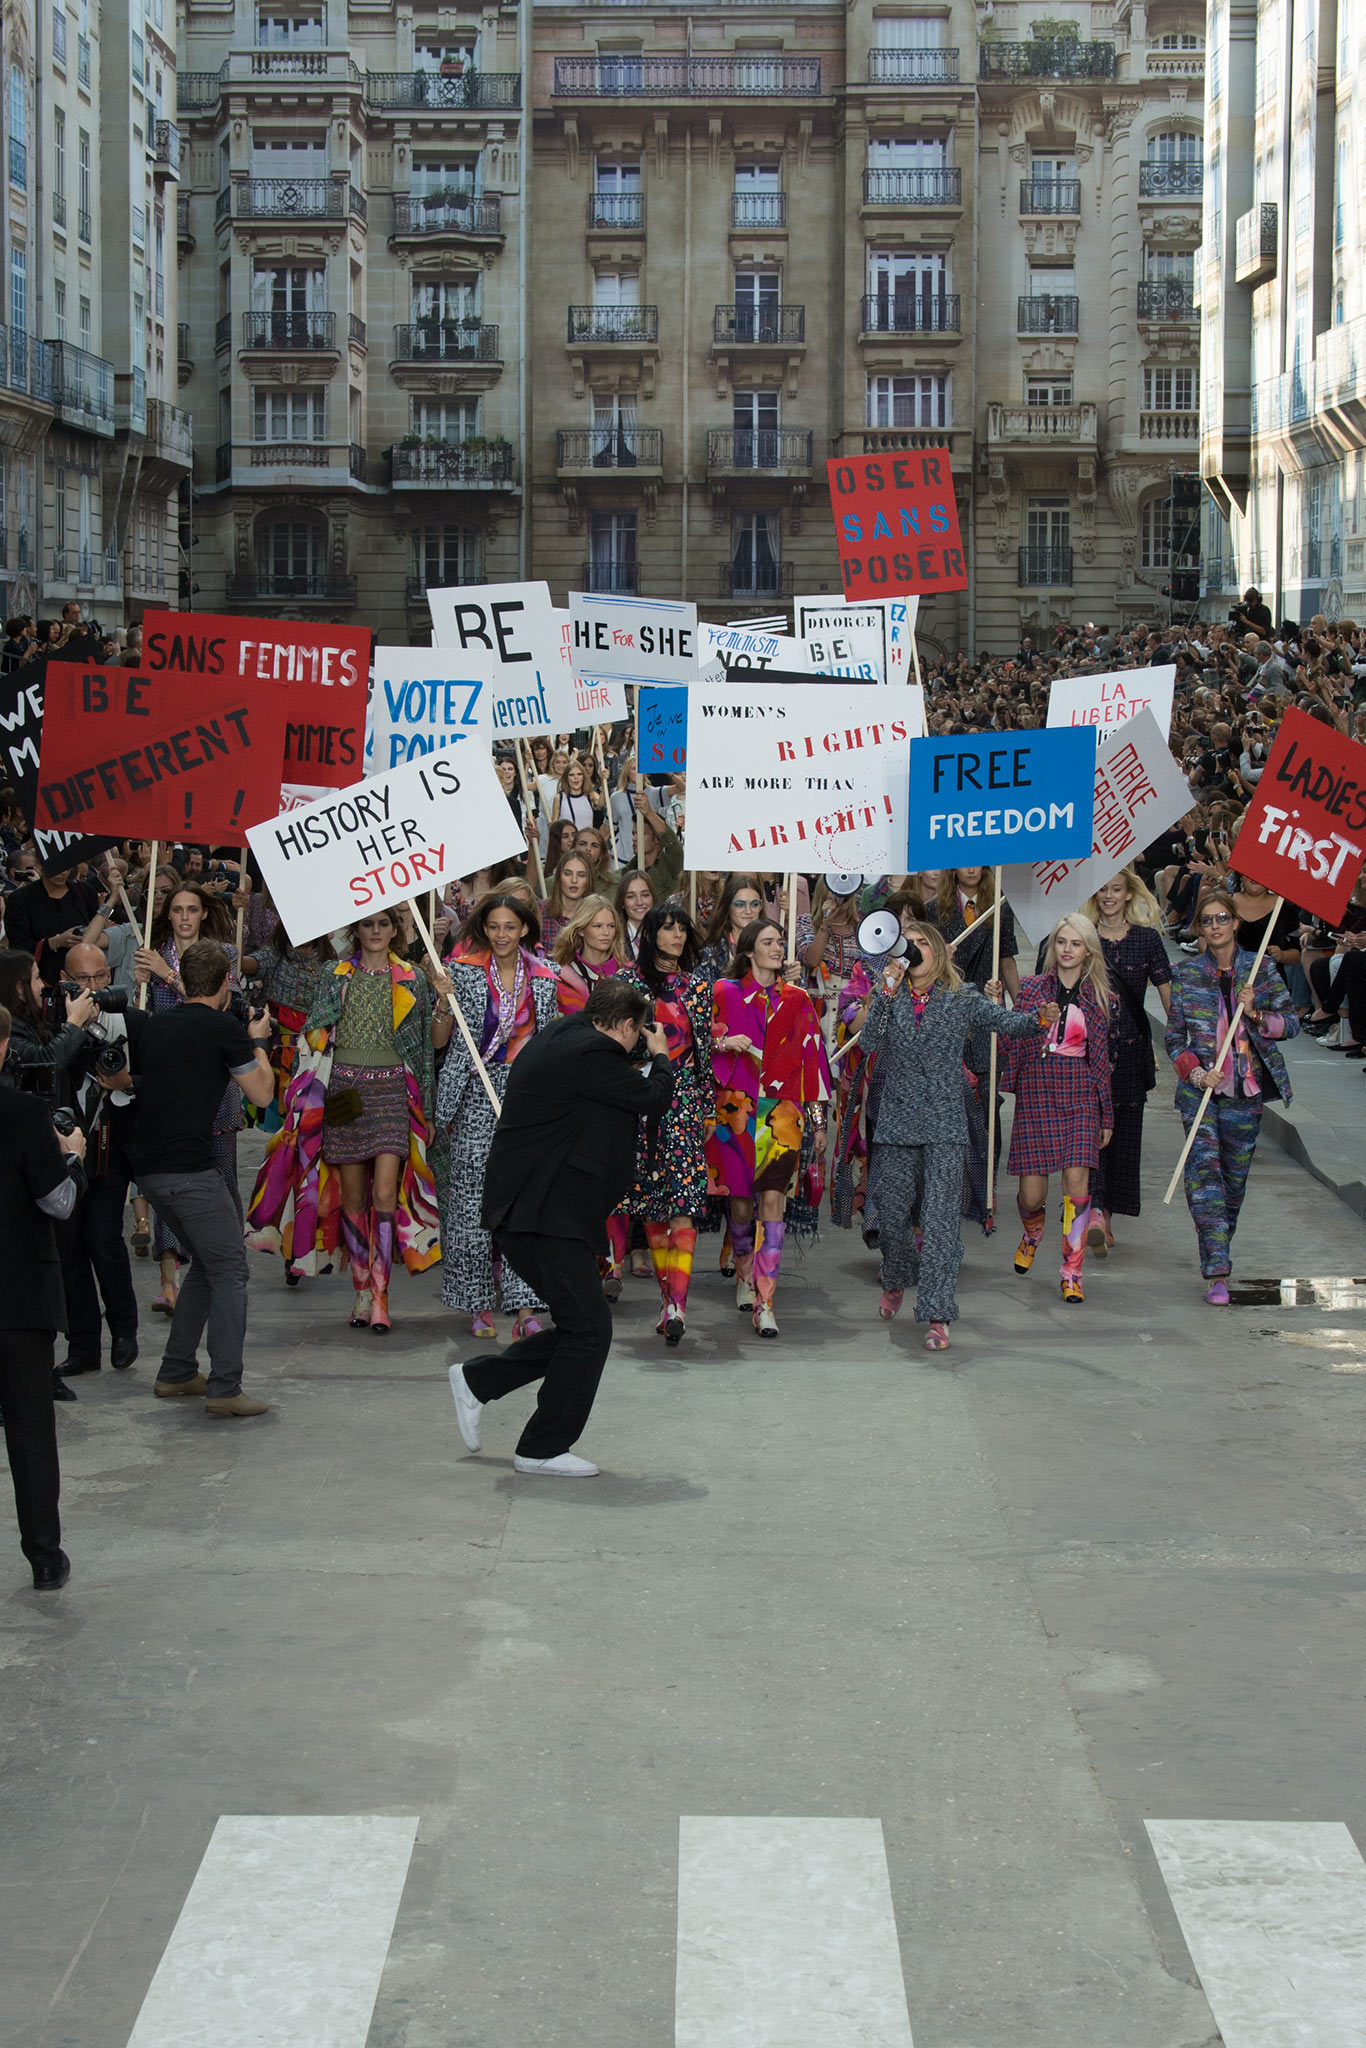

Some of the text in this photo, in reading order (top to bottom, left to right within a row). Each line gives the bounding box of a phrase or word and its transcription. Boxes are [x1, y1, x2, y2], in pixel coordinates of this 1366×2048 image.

[835, 457, 942, 494] OSER
[842, 504, 950, 542] SANS
[843, 548, 964, 587] POSER
[574, 620, 610, 650] HE
[640, 625, 693, 658] SHE
[808, 616, 876, 629] DIVORCE
[147, 633, 358, 687] SANS FEMMES
[707, 628, 780, 657] Feminism
[809, 639, 848, 663] BE
[82, 674, 151, 716] BE
[383, 679, 483, 725] VOTEZ
[575, 687, 611, 712] WAR
[1101, 682, 1126, 702] LA
[776, 720, 908, 762] RIGHTS
[40, 707, 251, 823] DIFFERENT
[698, 776, 854, 790] ARE MORE THAN
[933, 748, 1032, 793] FREE
[1107, 742, 1158, 818] MAKE
[274, 760, 461, 861] HISTORY IS
[929, 802, 1074, 840] FREEDOM
[356, 818, 427, 866] HER
[349, 843, 445, 906] STORY
